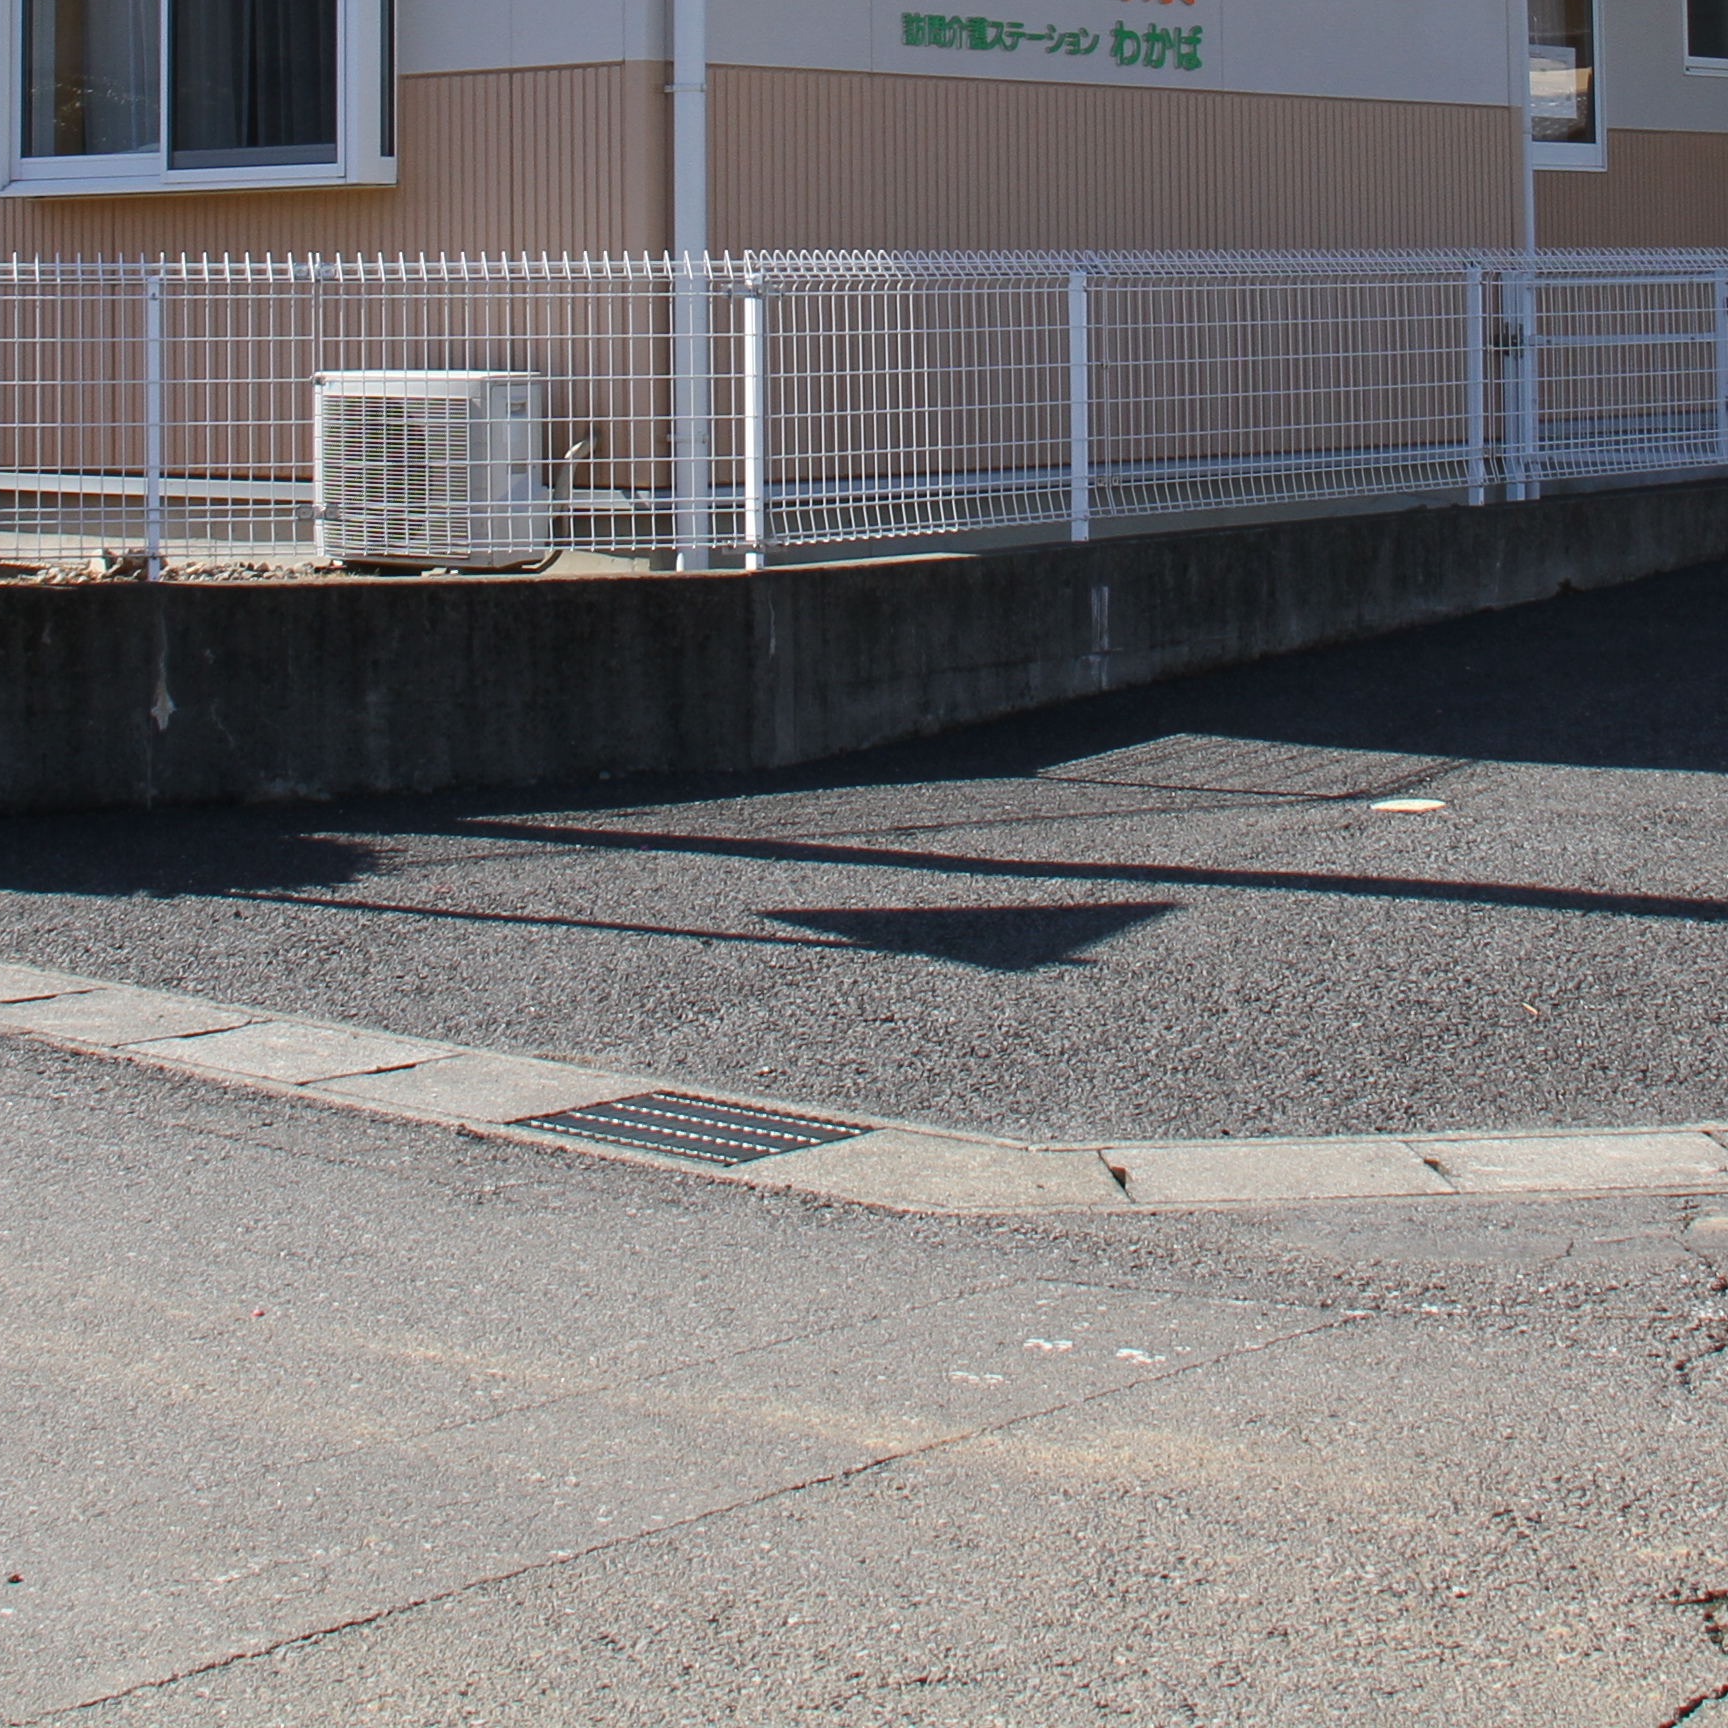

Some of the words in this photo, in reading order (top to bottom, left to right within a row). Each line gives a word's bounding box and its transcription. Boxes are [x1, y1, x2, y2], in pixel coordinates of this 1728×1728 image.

[901, 12, 1100, 56] 訪問介護ステーション
[1110, 20, 1203, 70] わかば
